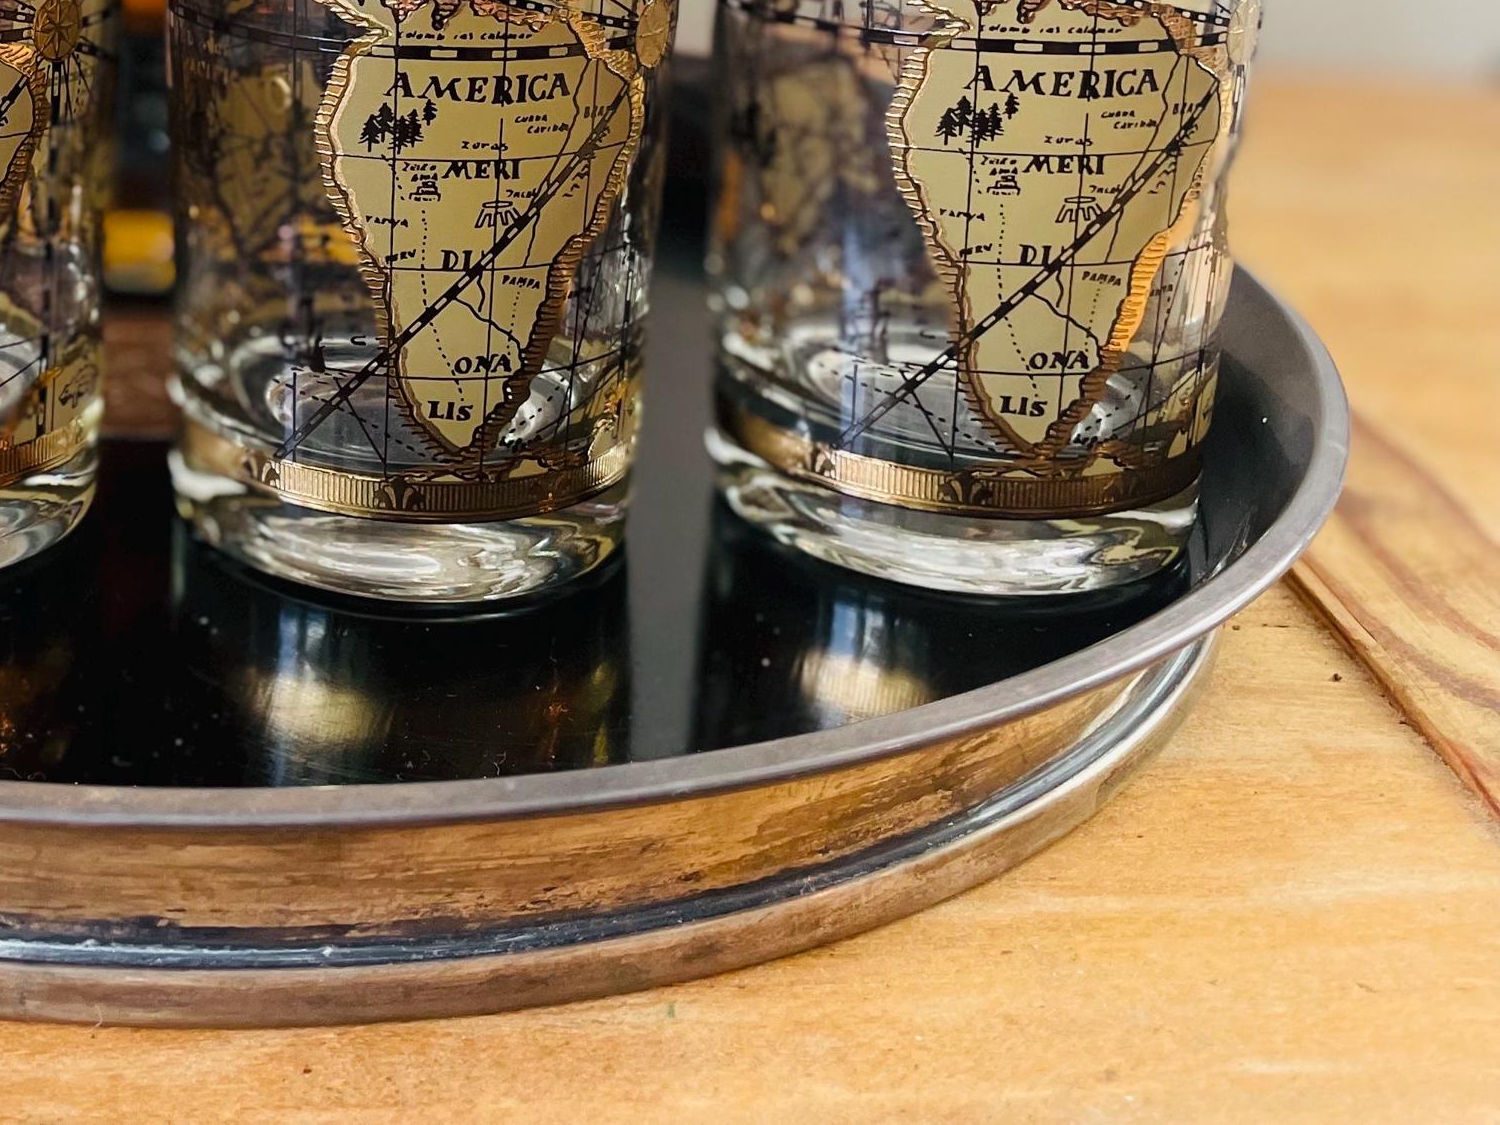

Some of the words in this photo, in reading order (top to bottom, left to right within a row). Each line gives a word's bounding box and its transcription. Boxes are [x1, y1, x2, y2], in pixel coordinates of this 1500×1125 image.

[384, 72, 570, 105] AMERICA
[964, 65, 1159, 99] AMERICA
[442, 160, 521, 180] MERI
[1022, 155, 1105, 174] MERI
[454, 354, 512, 374] ONA
[1029, 350, 1090, 369] ONA
[427, 401, 473, 421] LIS
[1000, 396, 1047, 417] LIS
